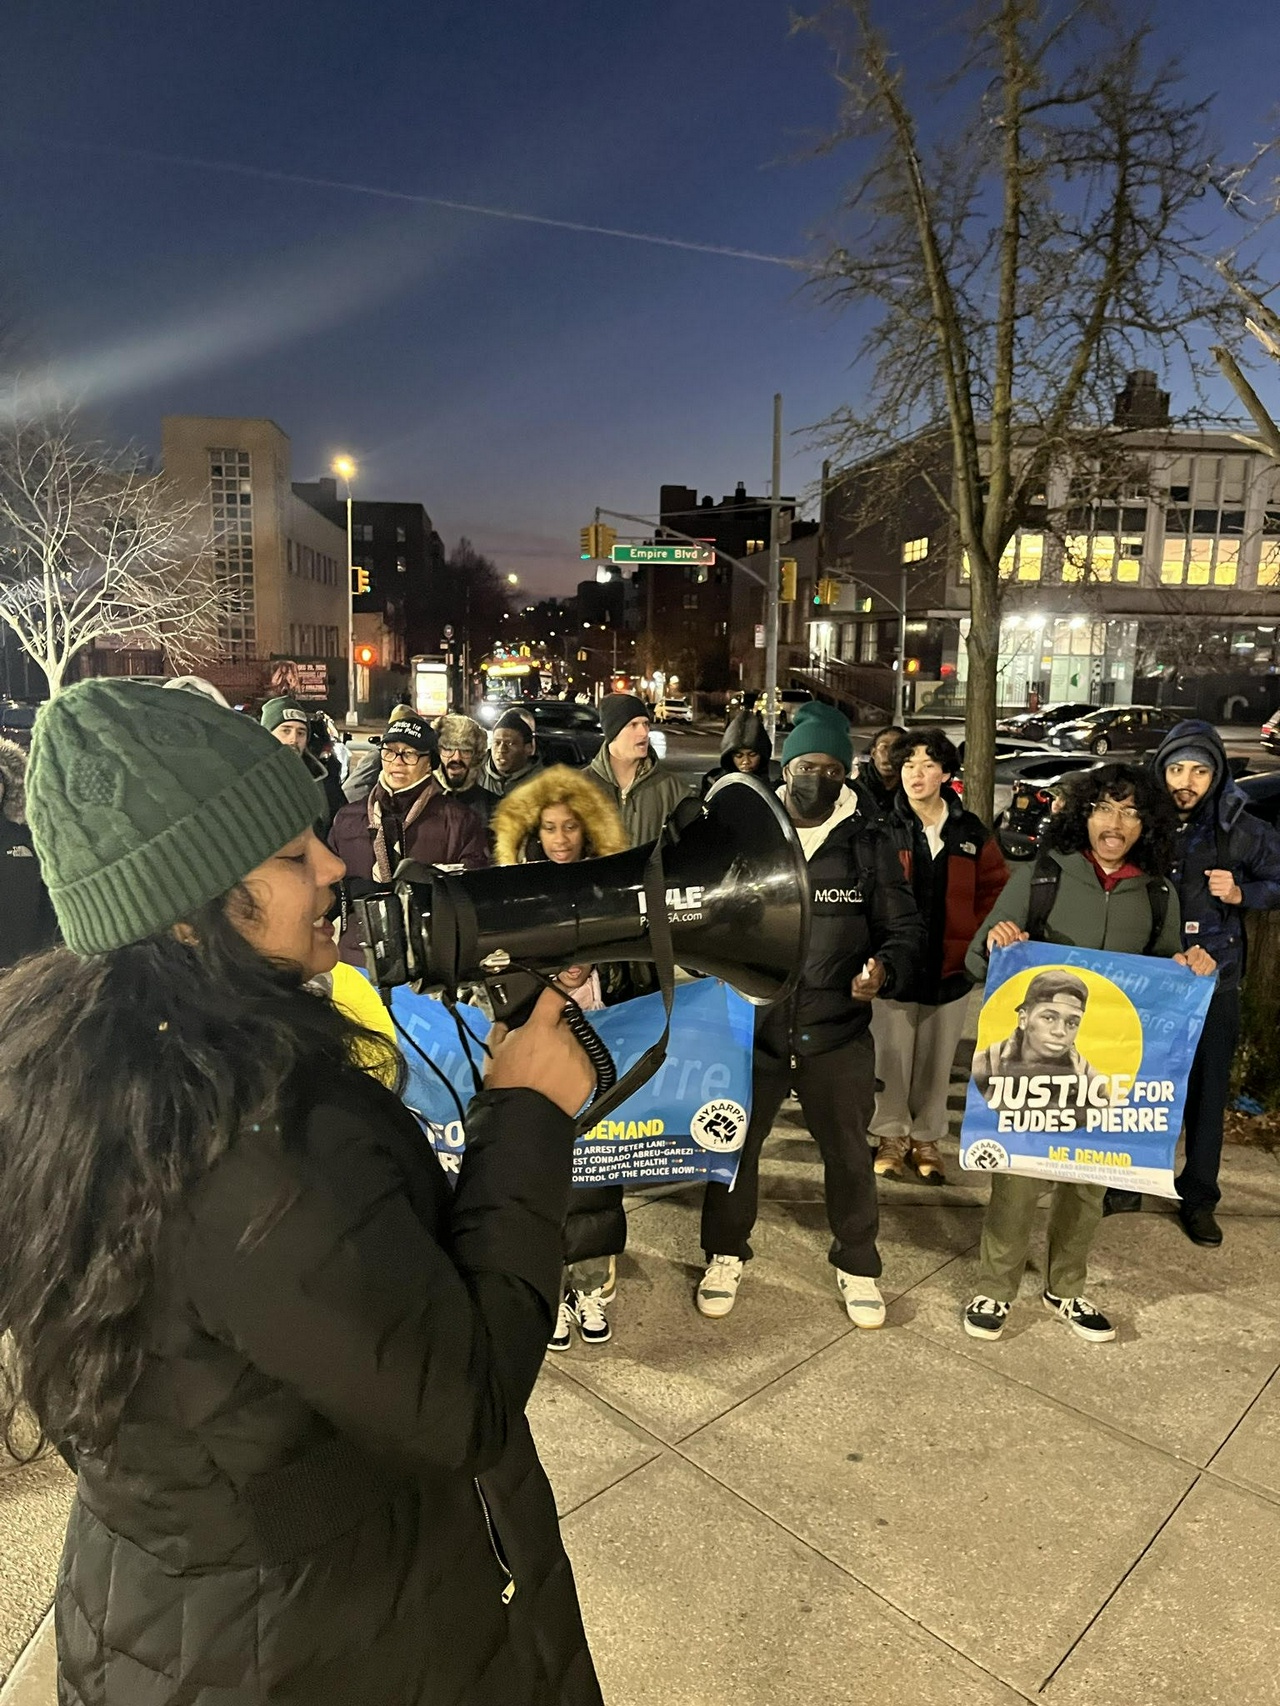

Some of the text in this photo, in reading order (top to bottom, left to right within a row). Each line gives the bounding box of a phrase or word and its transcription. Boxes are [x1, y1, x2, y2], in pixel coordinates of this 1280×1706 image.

[630, 549, 698, 560] Empire Blvd
[987, 1073, 1175, 1110] JUSTICE FOR
[697, 1103, 744, 1123] NYAARPR
[997, 1107, 1169, 1133] EUDES PIERRE
[584, 1145, 616, 1155] ARREST
[618, 1143, 645, 1153] PETER
[646, 1140, 665, 1148] LAN!
[589, 1153, 630, 1164] CONRADO
[1048, 1145, 1132, 1168] WE DEMAND
[585, 1166, 597, 1174] OF
[598, 1162, 631, 1174] MENTAL
[633, 1157, 668, 1168] HEALTH!
[608, 1171, 620, 1180] OF
[621, 1169, 639, 1178] THE
[640, 1167, 670, 1177] POLICE
[671, 1166, 695, 1174] NOW!
